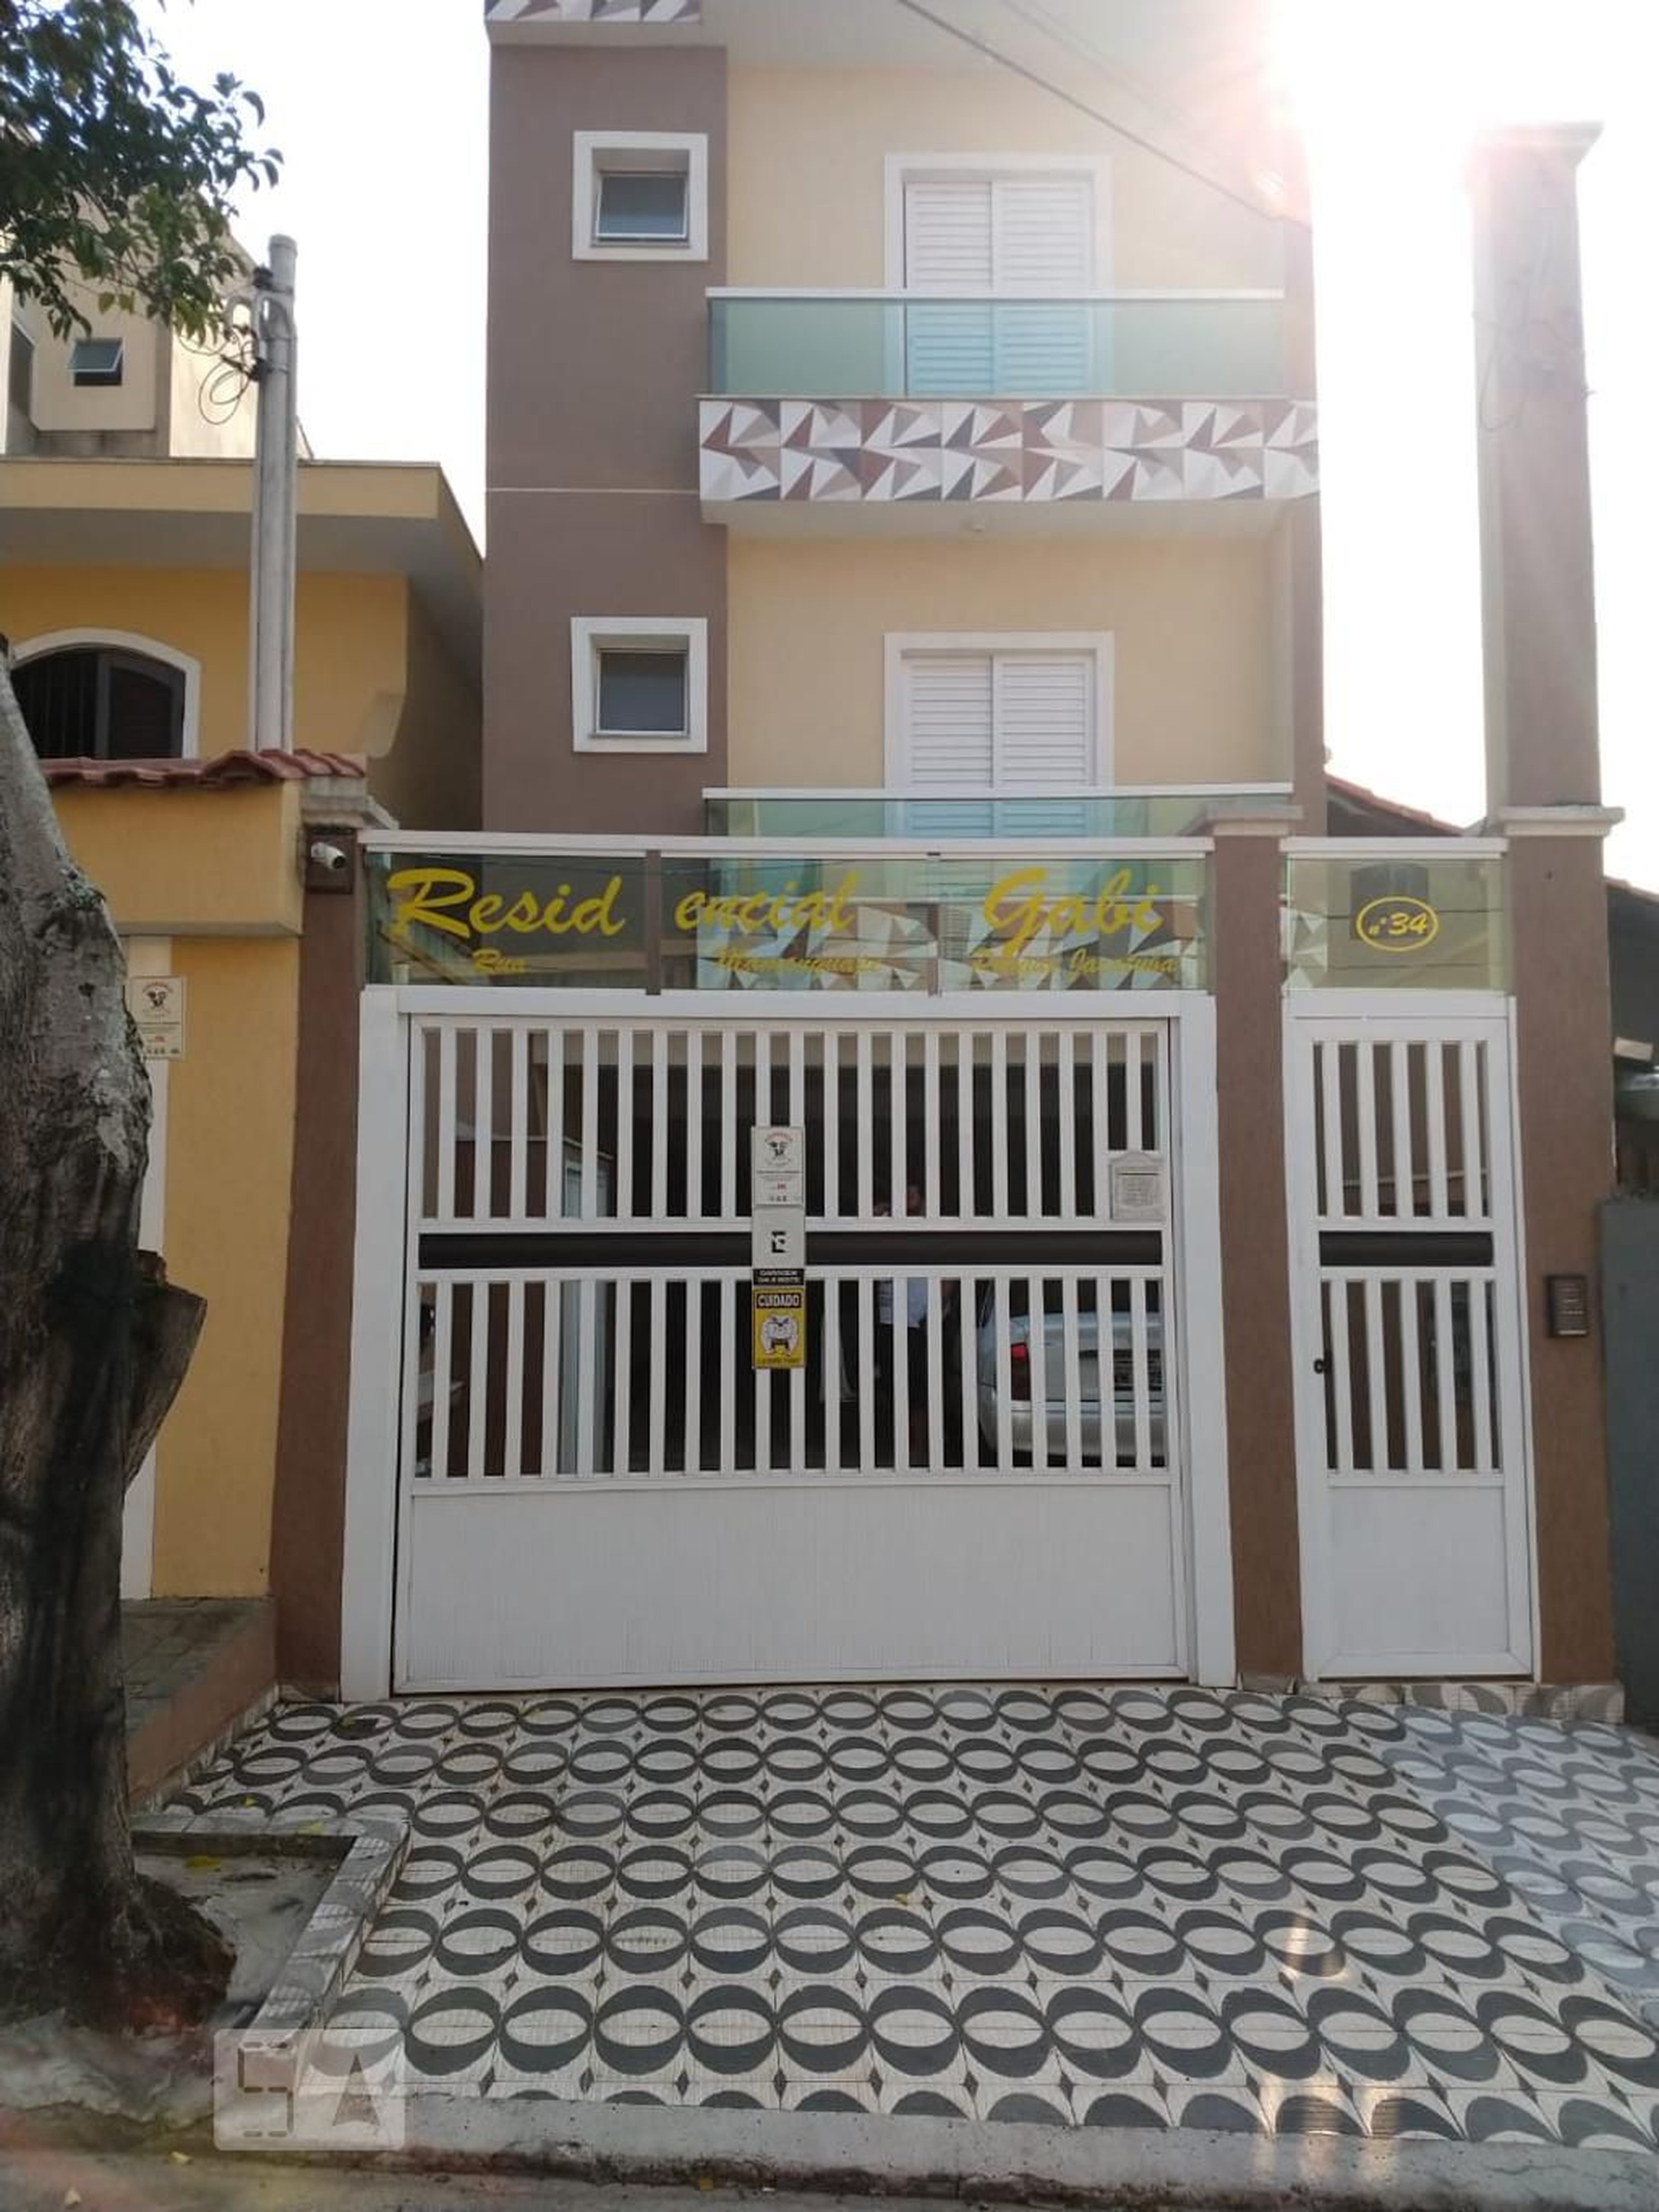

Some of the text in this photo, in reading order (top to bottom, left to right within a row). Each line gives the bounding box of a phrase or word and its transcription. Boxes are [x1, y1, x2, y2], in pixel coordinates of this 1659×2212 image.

[387, 867, 1166, 958] Resid encial Gabi
